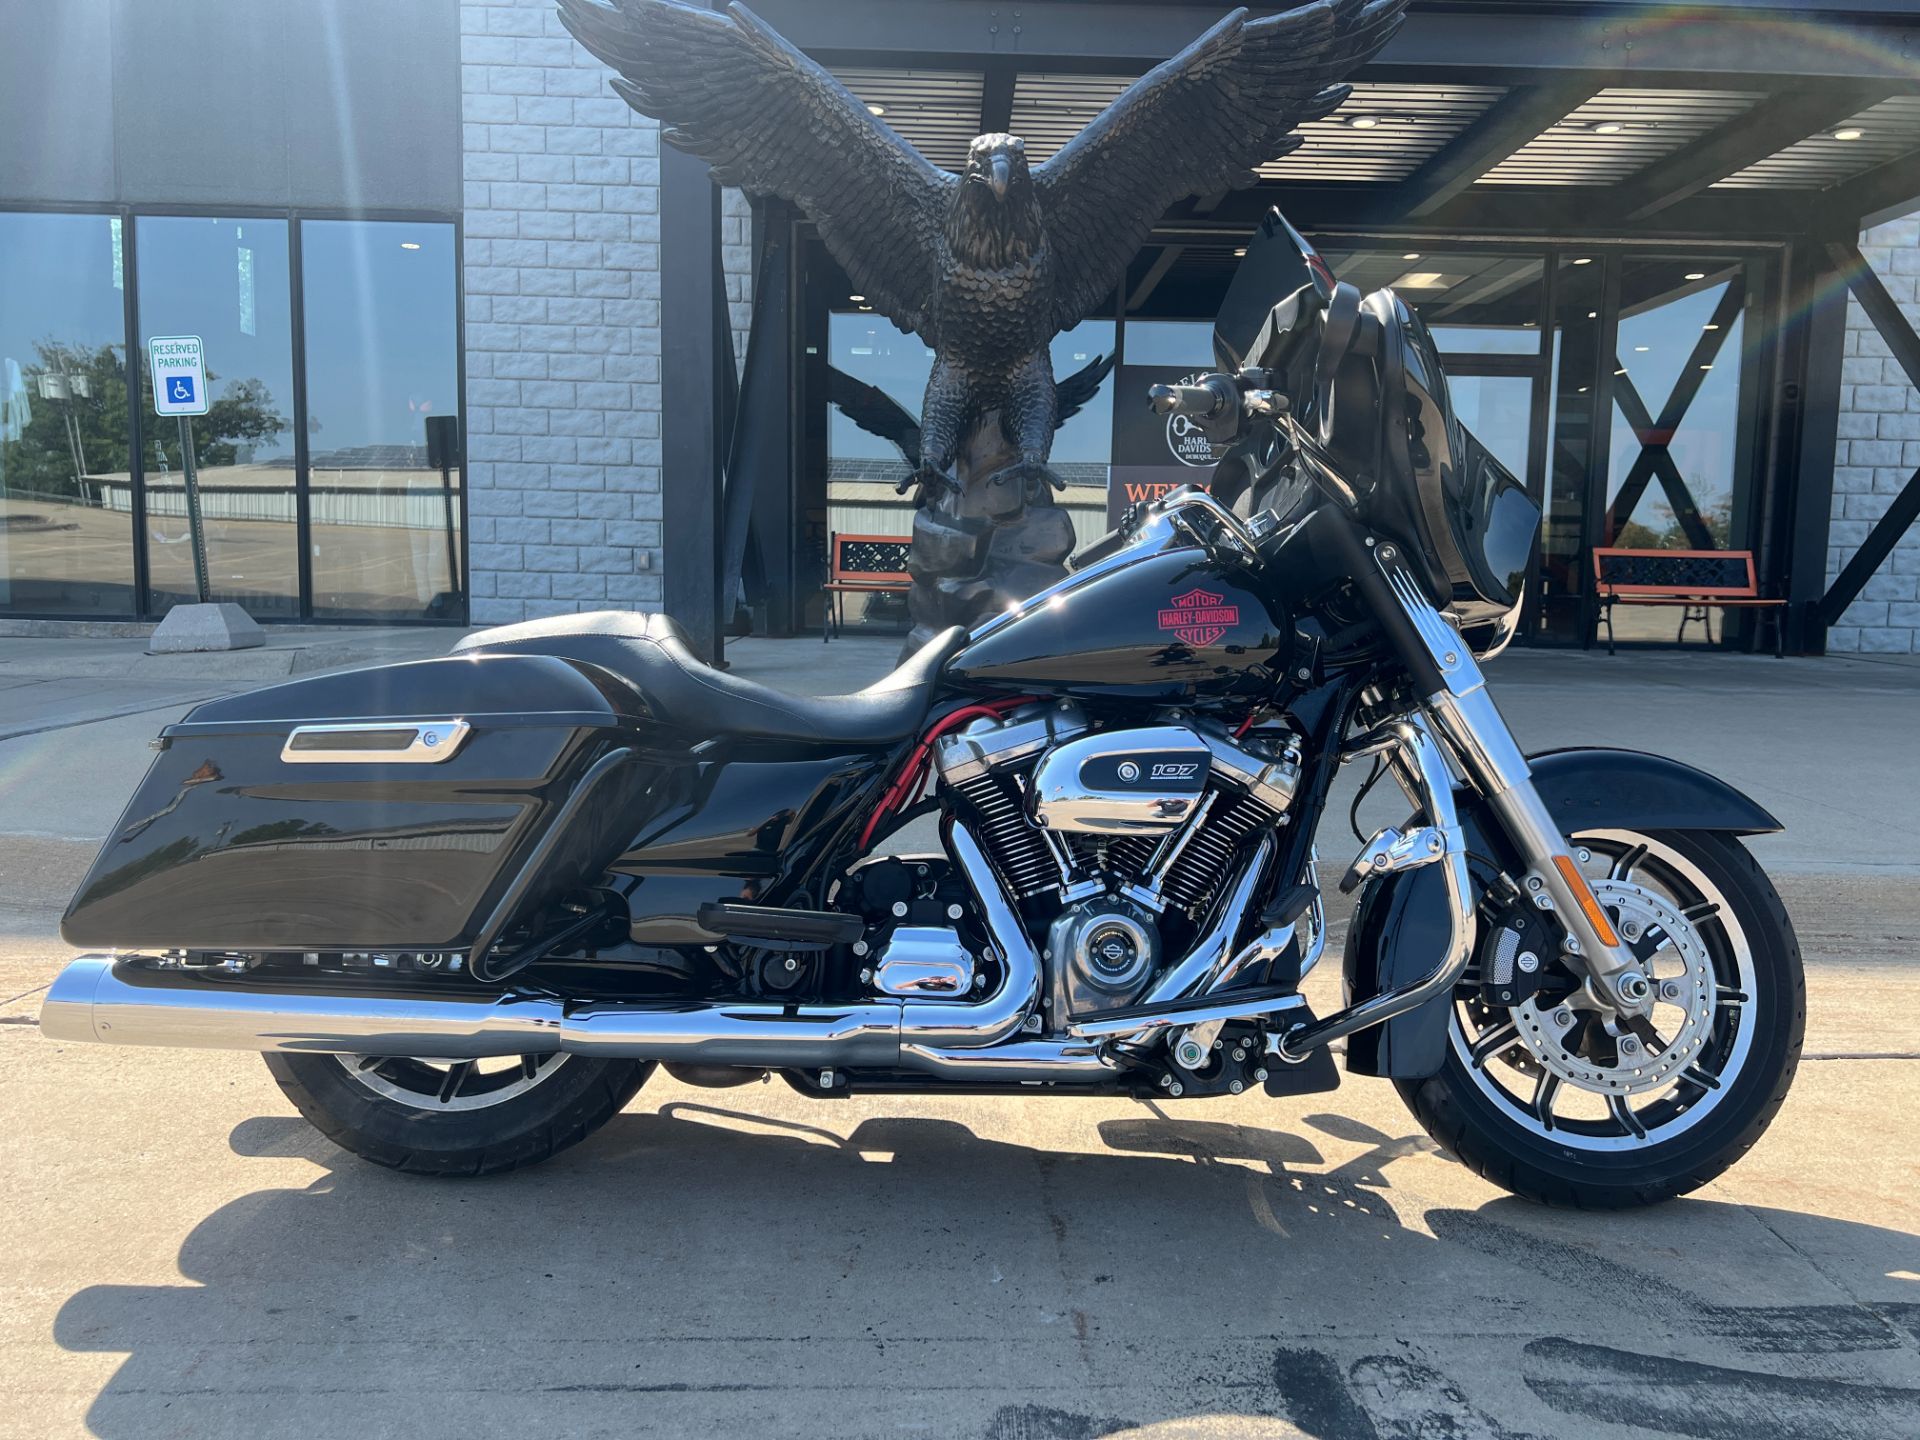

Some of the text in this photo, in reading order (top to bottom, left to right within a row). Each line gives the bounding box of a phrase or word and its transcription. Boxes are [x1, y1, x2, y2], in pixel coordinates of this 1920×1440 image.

[153, 343, 199, 355] RESERVED
[158, 357, 197, 368] PARKING
[1183, 436, 1208, 445] HARL
[1178, 444, 1213, 453] DAVIDS
[1178, 592, 1218, 608] MOTOR
[1161, 609, 1236, 626] HARLEY-DAVIDSON
[1179, 626, 1220, 645] CYCLES
[1151, 763, 1199, 776] 107
